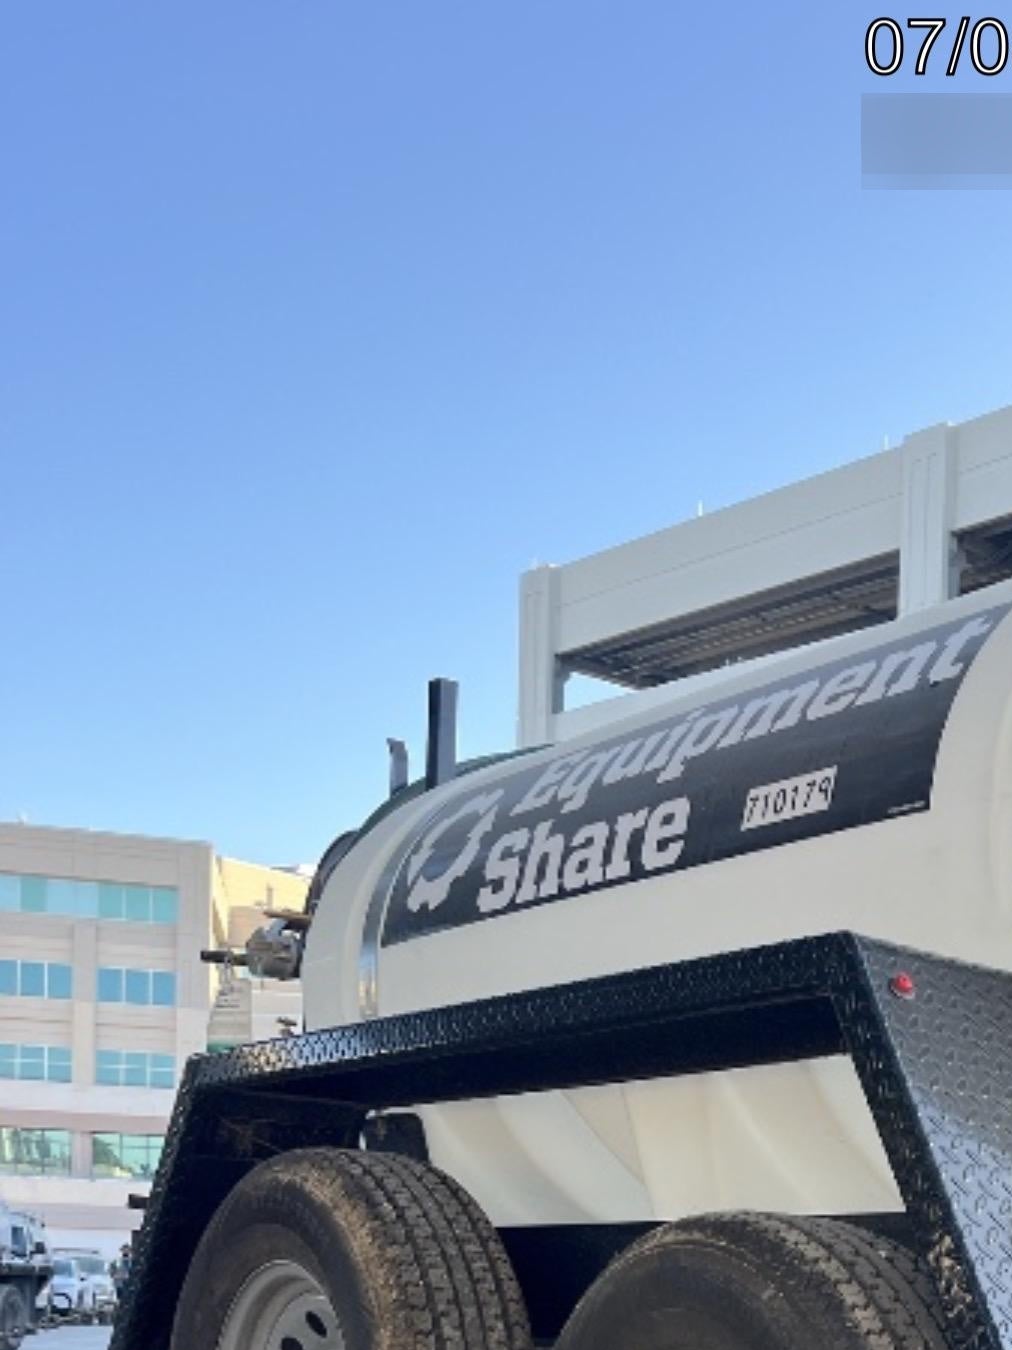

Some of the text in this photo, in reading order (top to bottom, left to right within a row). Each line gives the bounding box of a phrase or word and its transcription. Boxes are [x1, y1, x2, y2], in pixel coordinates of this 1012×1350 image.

[508, 615, 992, 817] Equipment
[475, 795, 692, 914] Share
[746, 776, 832, 823] 710179
